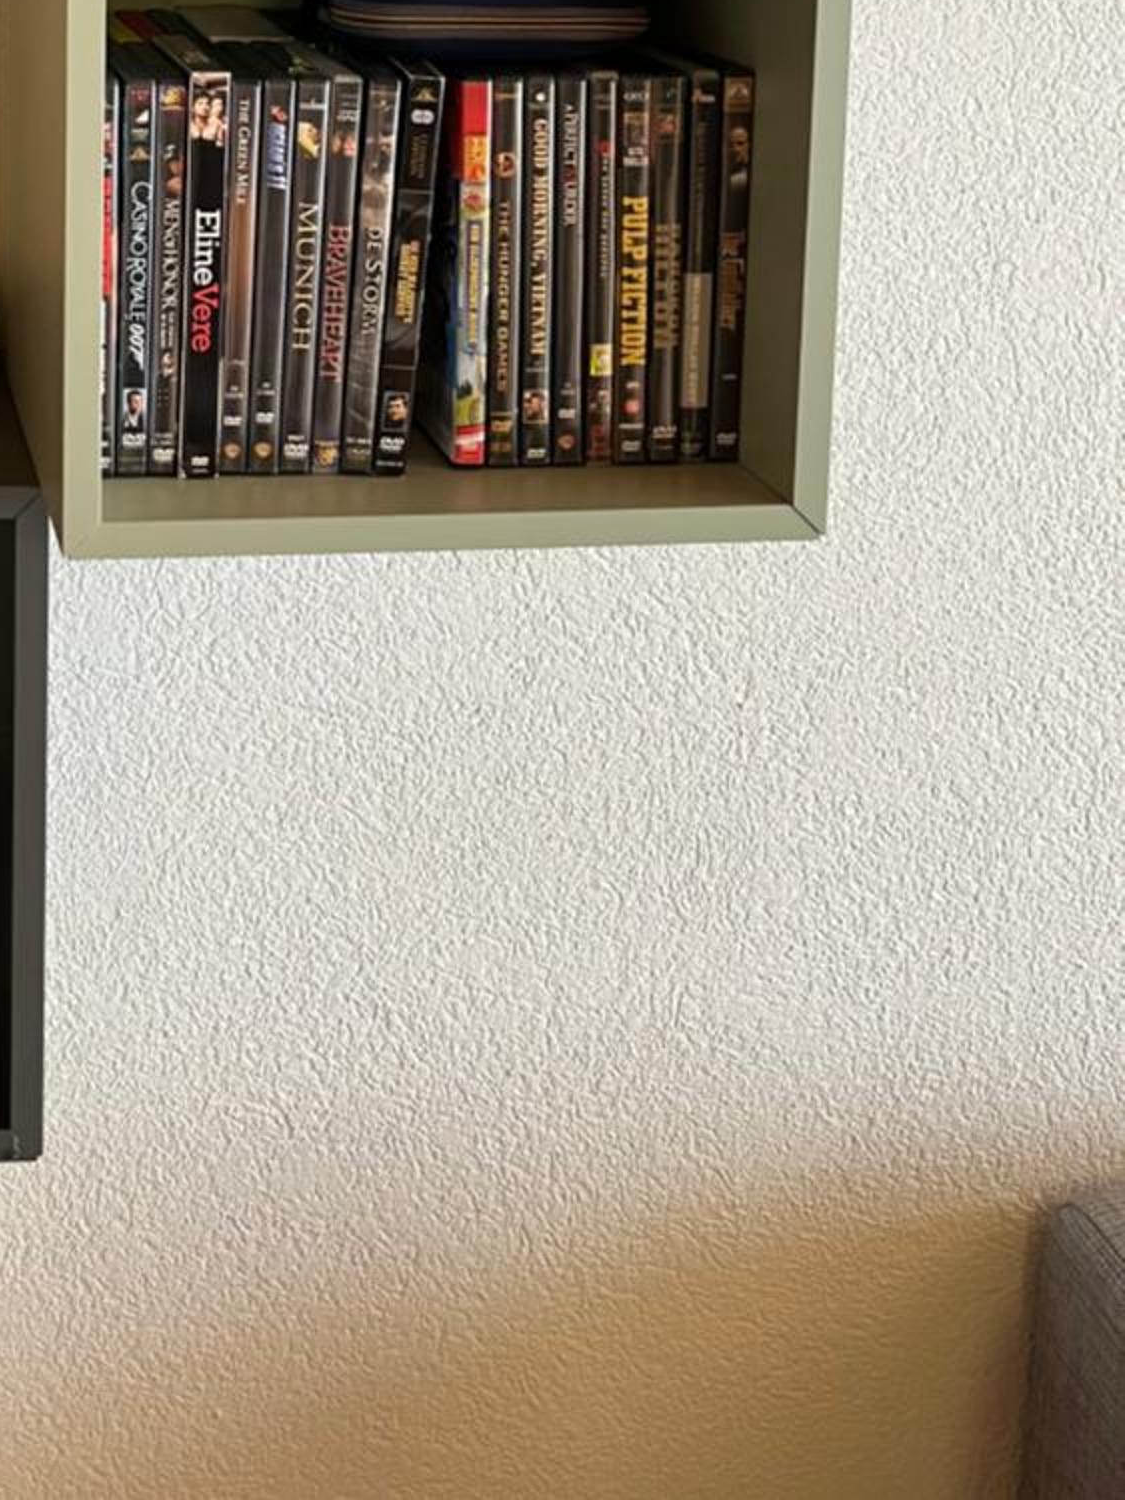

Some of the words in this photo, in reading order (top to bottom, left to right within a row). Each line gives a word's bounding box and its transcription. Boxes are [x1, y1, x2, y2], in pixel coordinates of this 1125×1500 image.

[533, 118, 548, 168] GOOD
[498, 200, 510, 235] THE
[531, 175, 548, 268] MORNING,
[622, 195, 649, 261] PULP
[291, 201, 320, 350] MUNICH
[319, 223, 351, 383] BRAVEHEART
[498, 242, 510, 322] HUNGER
[530, 273, 547, 355] VIETNAM
[620, 265, 648, 366] FICTION
[496, 327, 509, 392] GAMES
